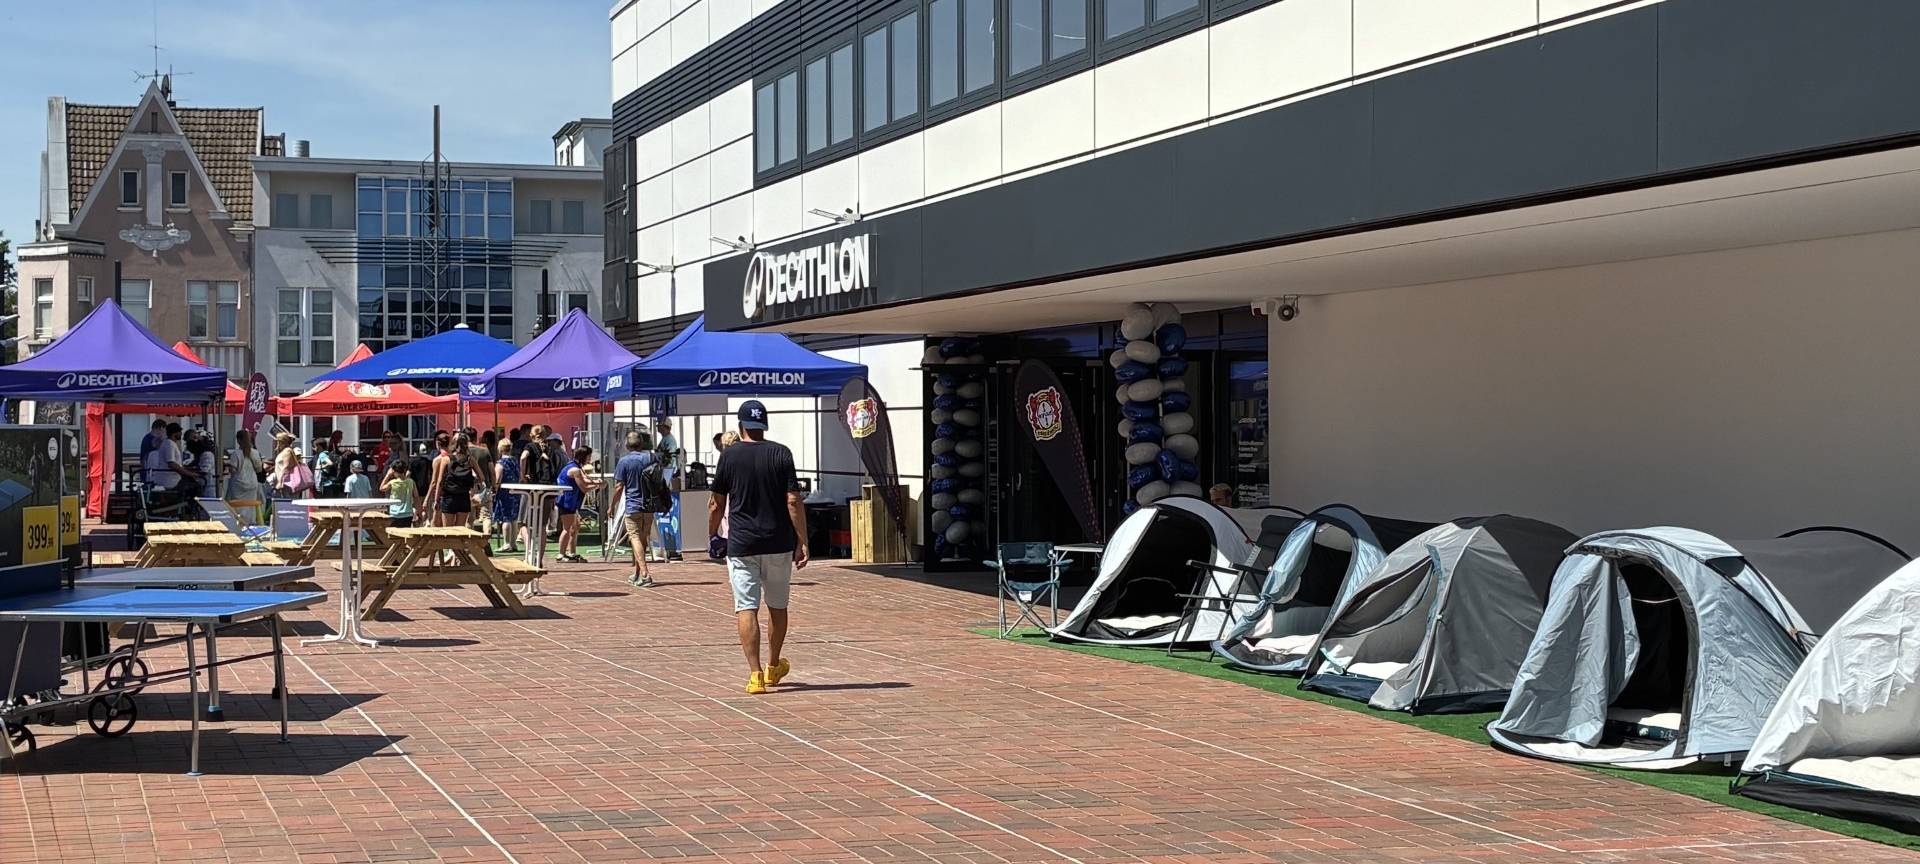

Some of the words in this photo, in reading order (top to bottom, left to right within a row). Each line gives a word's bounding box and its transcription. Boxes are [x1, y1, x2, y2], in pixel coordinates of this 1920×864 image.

[765, 233, 869, 306] DECATHLON
[407, 367, 486, 375] DECATHLON
[79, 373, 163, 386] DECATHLON
[572, 378, 599, 389] DEC
[720, 372, 805, 385] DECATHLON
